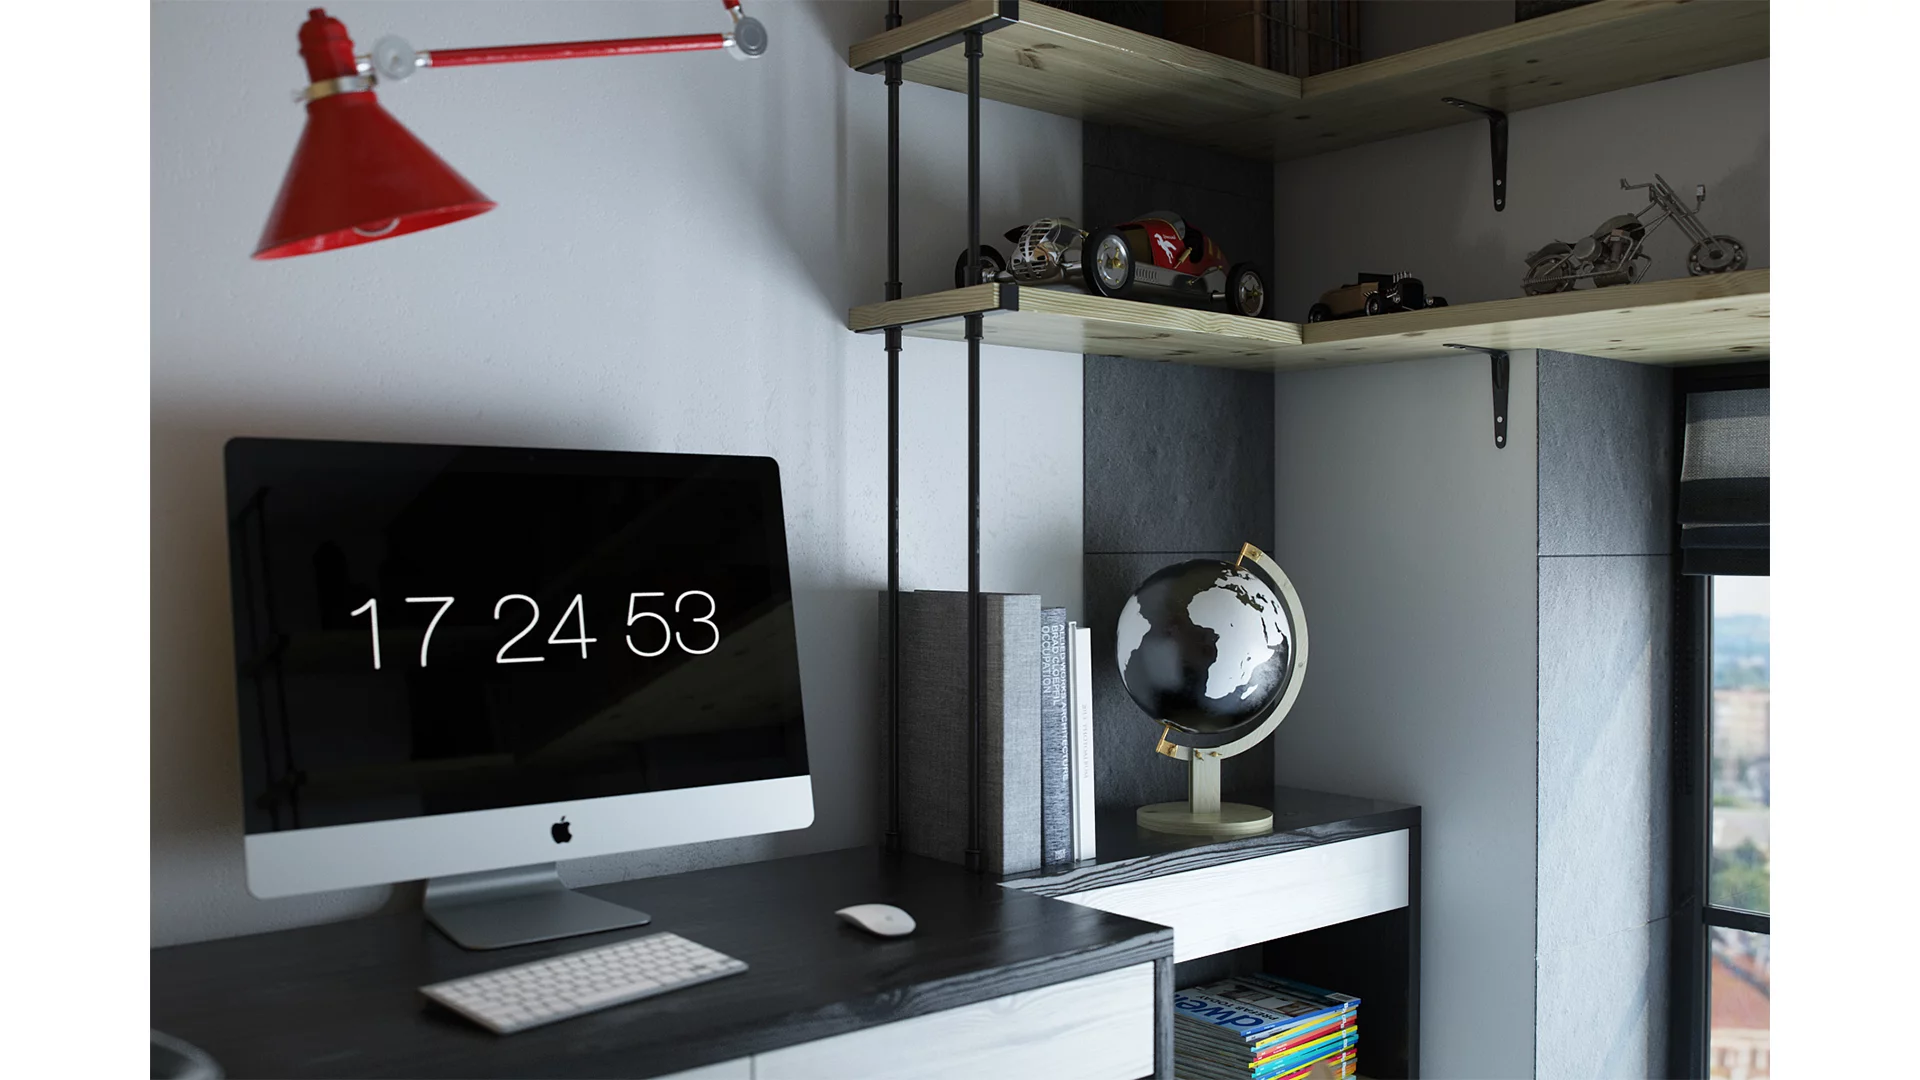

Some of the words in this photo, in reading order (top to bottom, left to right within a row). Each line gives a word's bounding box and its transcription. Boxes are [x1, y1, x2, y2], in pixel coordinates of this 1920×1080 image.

[350, 597, 455, 670] 17
[493, 593, 598, 664] 24
[625, 590, 720, 657] 53
[1042, 625, 1051, 694] OCCUPATION
[1052, 656, 1060, 706] CLOEPFIL
[1174, 994, 1264, 1027] dwe
[1198, 995, 1234, 1008] TODAY
[1235, 1006, 1280, 1021] PREFAB
